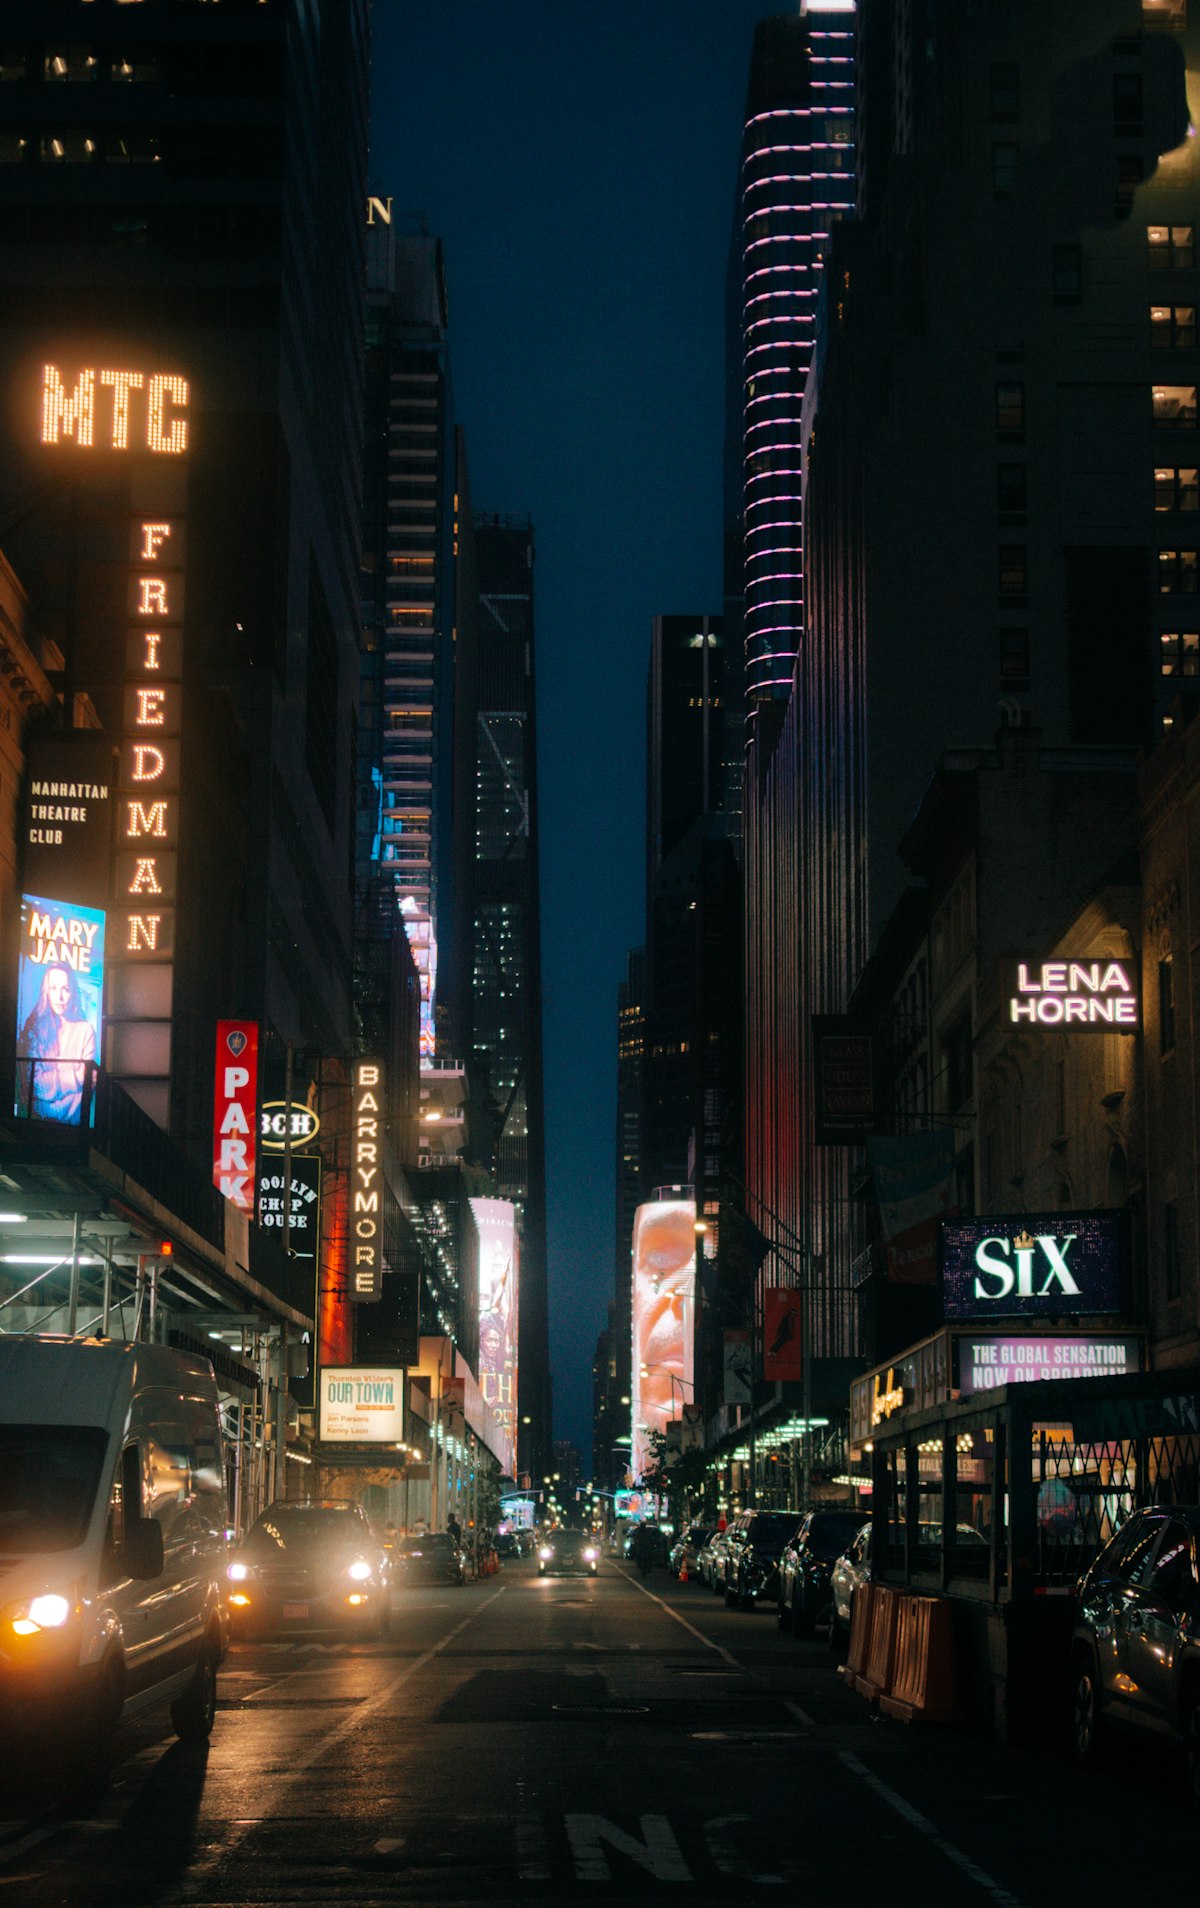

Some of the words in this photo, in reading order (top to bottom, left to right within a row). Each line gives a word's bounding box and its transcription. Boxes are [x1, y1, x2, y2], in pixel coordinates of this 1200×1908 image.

[41, 363, 190, 454] MTC
[127, 523, 170, 950] FRIEDMAN
[31, 781, 108, 799] MANHATTAN
[31, 804, 87, 822] THEATRE
[29, 828, 63, 845] CLUB
[28, 911, 99, 949] MARY
[29, 938, 91, 973] JANE
[1018, 963, 1130, 992] LENA
[1010, 997, 1137, 1023] HORNE
[219, 1066, 250, 1208] PARK
[354, 1065, 379, 1292] BARRYMORE
[260, 1214, 308, 1228] OUSE
[972, 1345, 998, 1364] THE
[1000, 1345, 1050, 1364] GLOBAL
[1053, 1345, 1126, 1364] SENSATION
[972, 1366, 1008, 1389] NOW
[327, 1382, 353, 1403] OUR
[355, 1382, 394, 1404] TOWN
